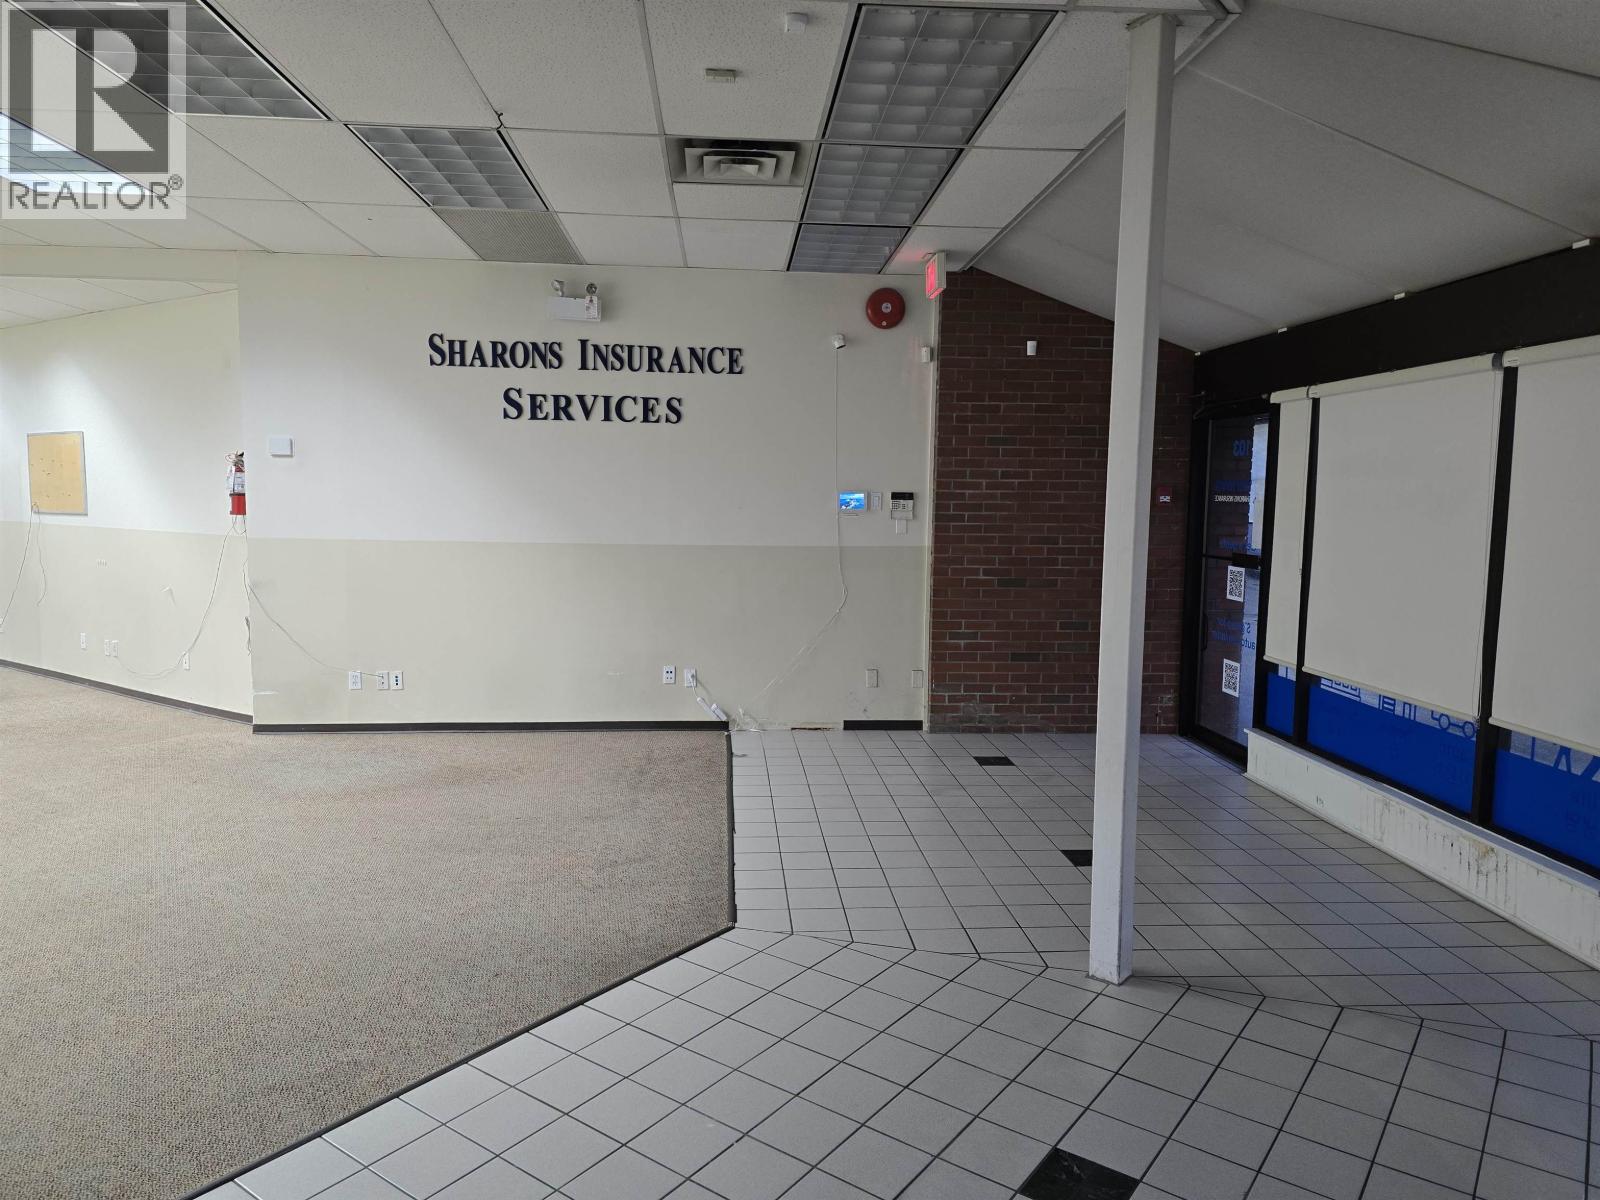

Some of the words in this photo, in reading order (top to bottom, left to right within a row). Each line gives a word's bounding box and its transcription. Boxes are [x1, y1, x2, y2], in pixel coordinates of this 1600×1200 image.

[427, 332, 564, 370] SHARONS
[577, 338, 745, 376] INSURANCE
[502, 387, 683, 425] SERVICES
